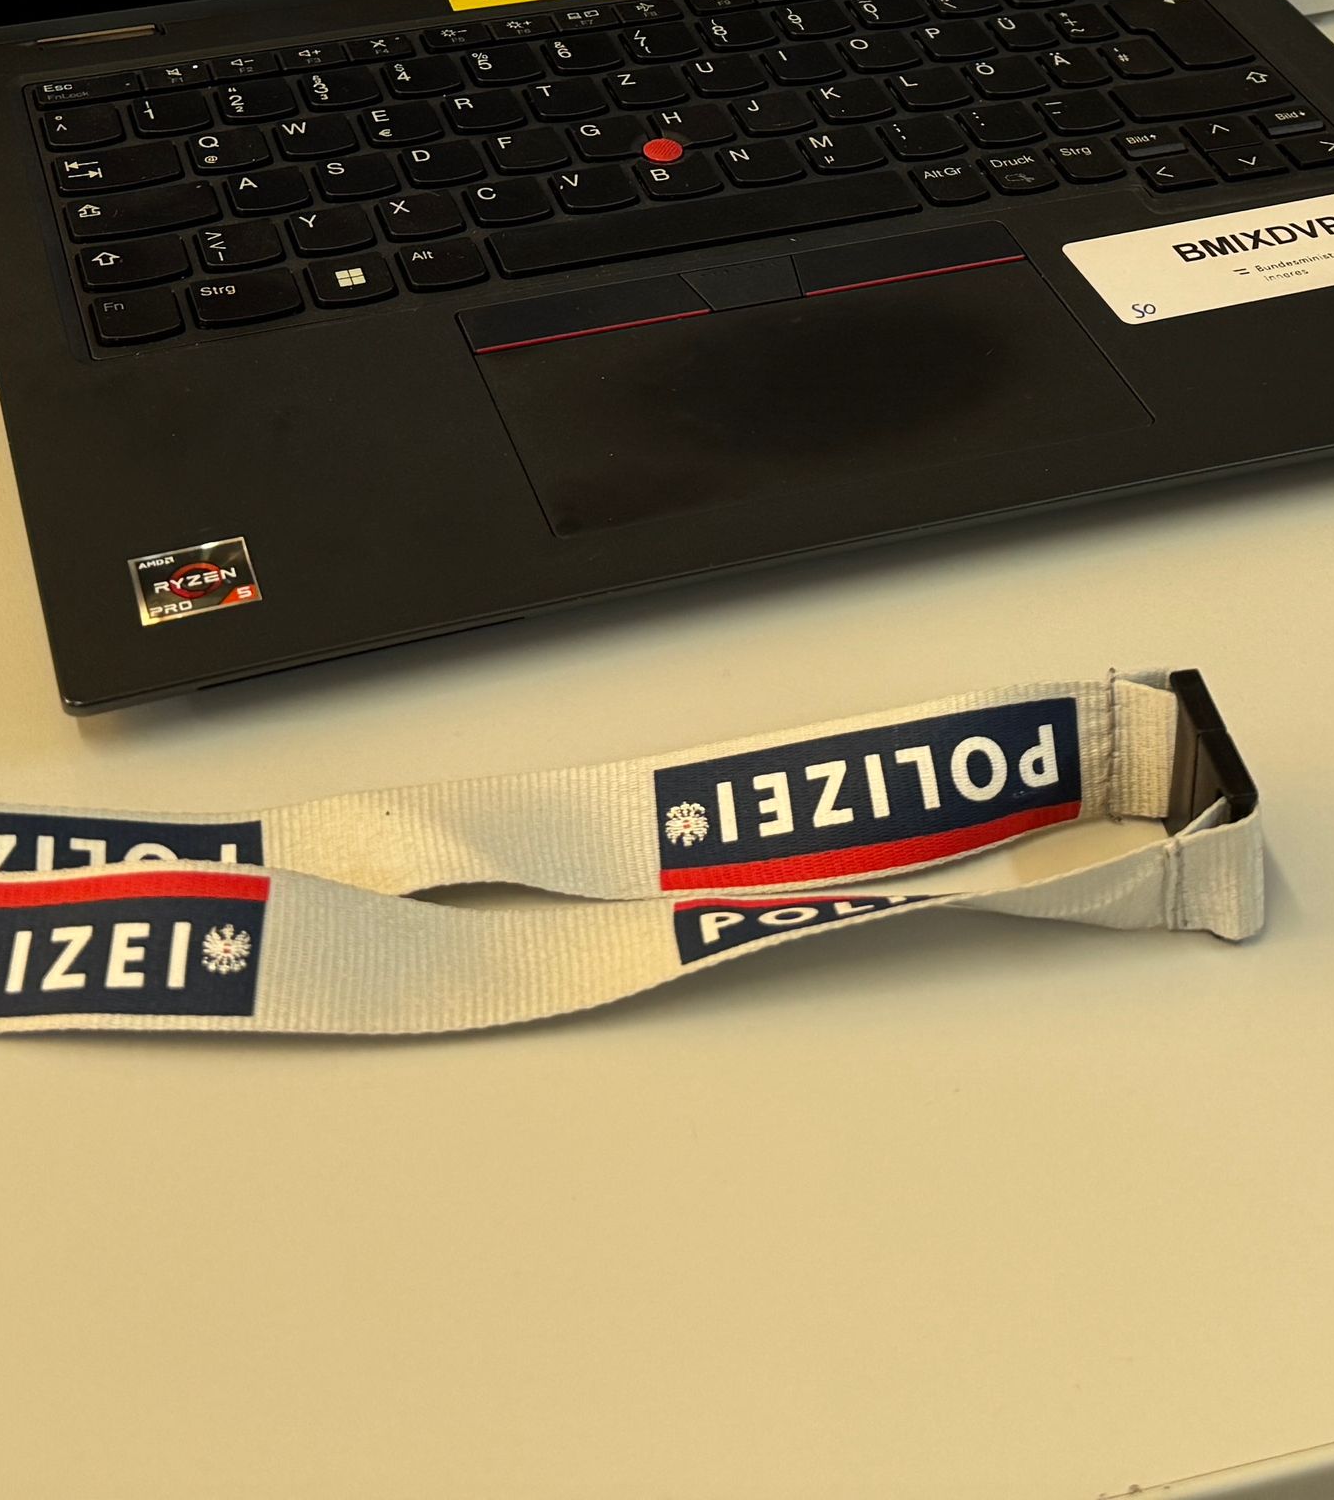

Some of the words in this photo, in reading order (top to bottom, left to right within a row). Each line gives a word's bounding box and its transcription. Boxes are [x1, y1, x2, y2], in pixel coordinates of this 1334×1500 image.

[997, 17, 1016, 30] Ü
[924, 27, 941, 39] P
[849, 38, 869, 50] O
[554, 47, 572, 59] 6
[1051, 52, 1071, 66] Ä
[477, 56, 493, 71] 5
[695, 61, 714, 73] U
[975, 62, 995, 76] Ö
[395, 68, 412, 82] 4
[617, 73, 636, 86] Z
[899, 75, 919, 87] L
[42, 83, 73, 93] Esc
[535, 84, 552, 97] T
[820, 86, 841, 100] K
[453, 97, 474, 110] R
[747, 99, 760, 112] J
[371, 109, 390, 123] E
[661, 111, 682, 125] H
[1274, 111, 1299, 121] Bild
[281, 121, 307, 135] W
[579, 124, 601, 137] G
[198, 135, 220, 149] Q
[497, 136, 512, 150] F
[808, 135, 834, 149] M
[1125, 134, 1151, 145] Bild
[411, 149, 431, 163] D
[728, 148, 750, 162] N
[1059, 146, 1092, 157] Strg
[989, 154, 1035, 168] Druck
[326, 162, 345, 175] S
[649, 168, 670, 182] B
[924, 169, 945, 180] Alt
[238, 177, 258, 190] A
[566, 173, 579, 190] V
[476, 187, 497, 200] C
[389, 200, 411, 215] X
[298, 214, 317, 228] Y
[411, 250, 434, 261] Alt
[199, 285, 236, 297] Strg
[103, 301, 125, 312] Fn
[138, 558, 165, 570] AMD
[154, 567, 236, 593] RYZEN
[237, 586, 252, 598] 5
[149, 600, 193, 617] PRO
[716, 723, 1061, 843] POLIZEI
